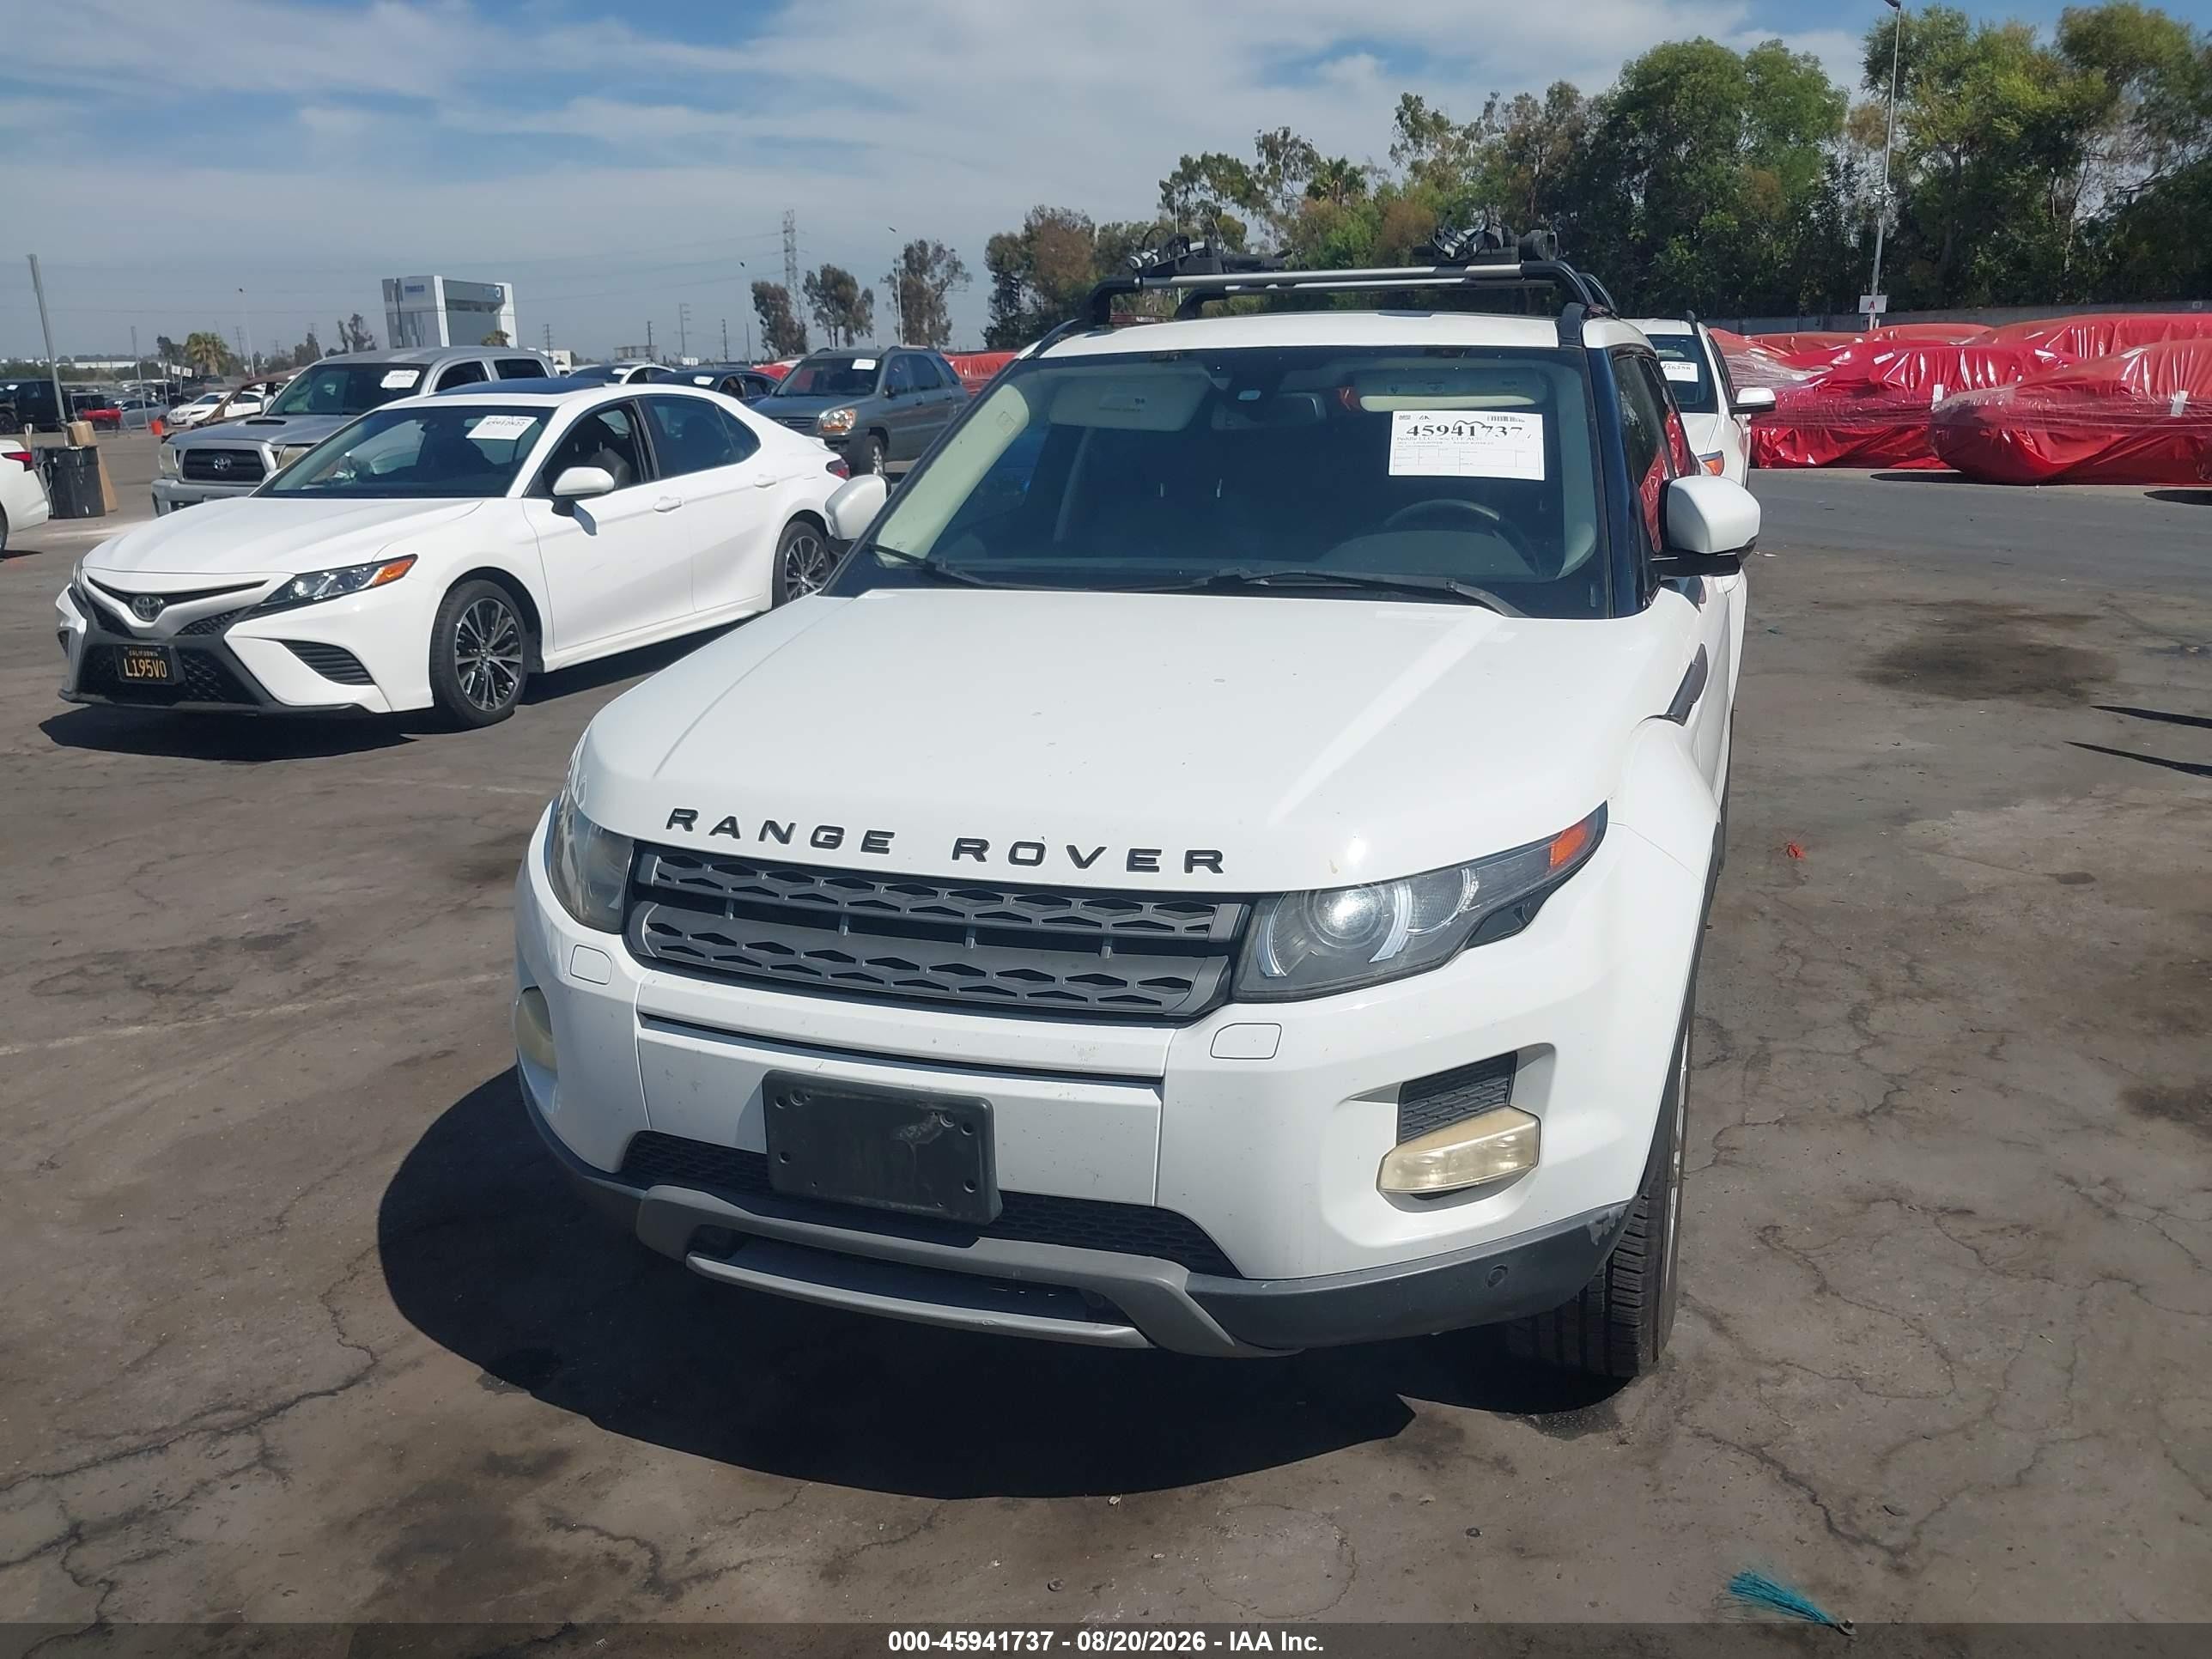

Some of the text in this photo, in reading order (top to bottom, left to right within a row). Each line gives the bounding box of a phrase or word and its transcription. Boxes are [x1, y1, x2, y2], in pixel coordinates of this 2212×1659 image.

[1869, 301, 1875, 310] A
[1407, 424, 1523, 437] 45941737
[665, 807, 1224, 874] RANGE ROVER
